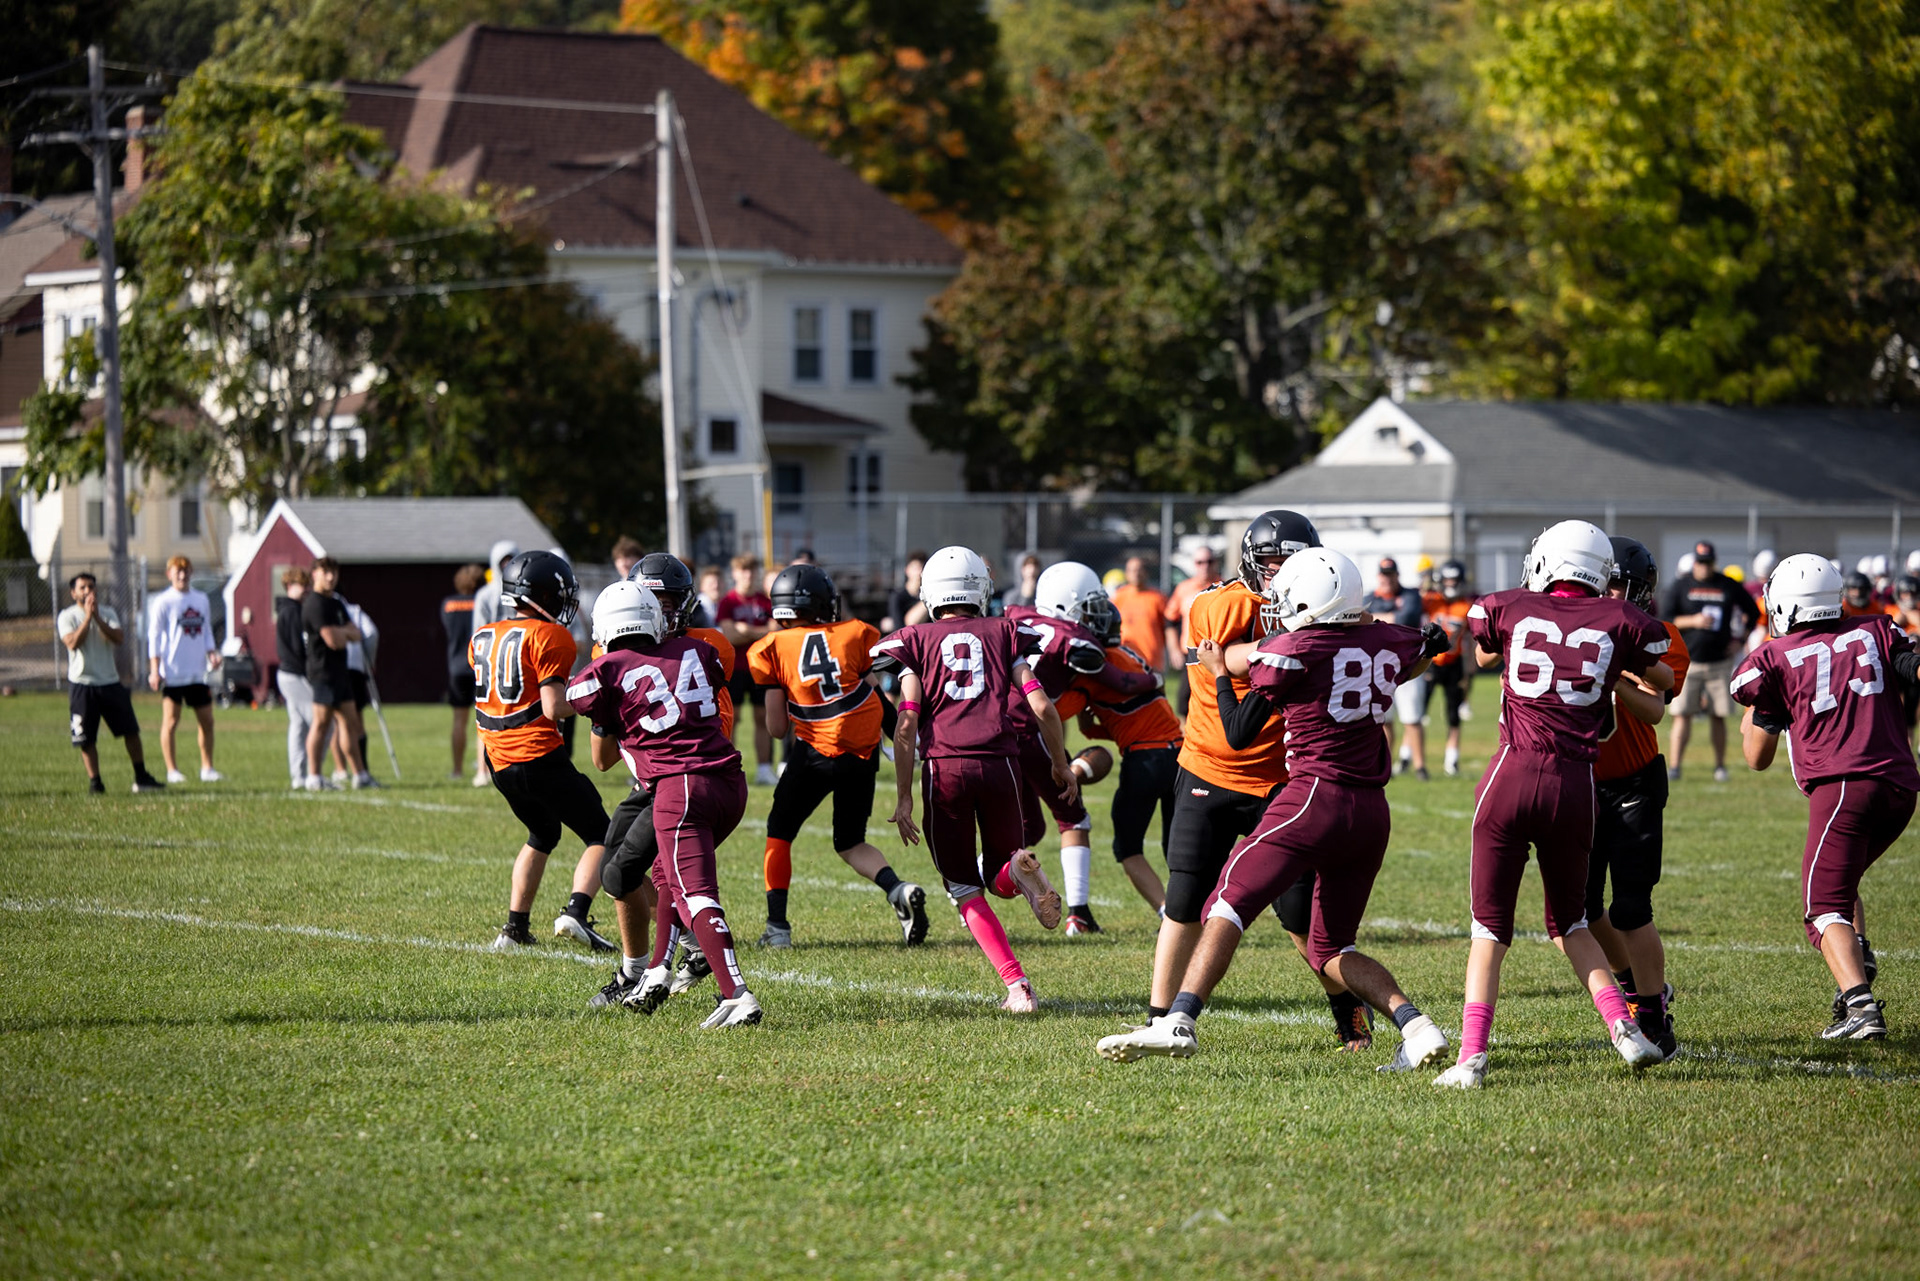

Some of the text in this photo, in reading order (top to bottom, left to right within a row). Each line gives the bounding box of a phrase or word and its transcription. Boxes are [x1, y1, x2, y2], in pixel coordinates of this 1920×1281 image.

[942, 595, 967, 603] schutt
[1571, 570, 1599, 584] schutt
[615, 624, 642, 635] schutt
[1813, 610, 1838, 618] schutt
[621, 648, 717, 734] 34
[798, 631, 844, 702] 4
[940, 632, 985, 700] 9
[1327, 647, 1401, 724] 89
[1508, 616, 1615, 707] 63
[1784, 628, 1884, 715] 73
